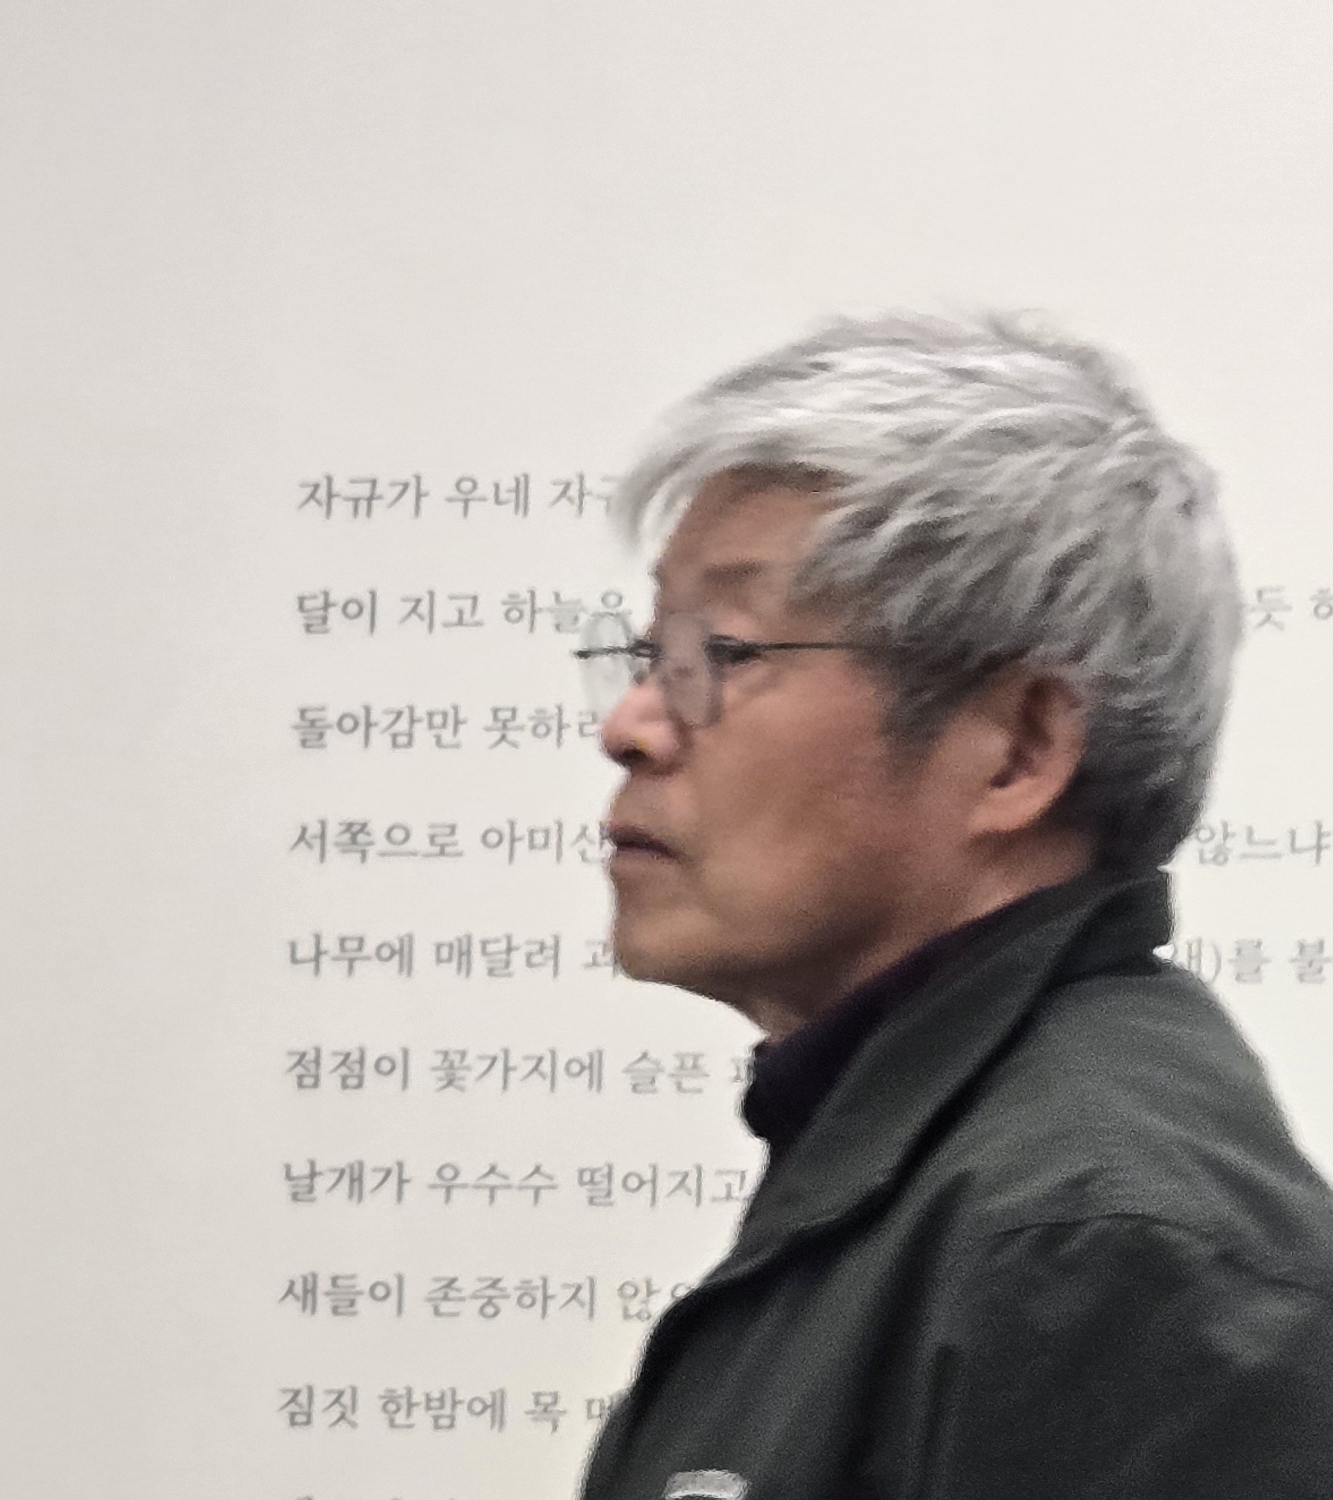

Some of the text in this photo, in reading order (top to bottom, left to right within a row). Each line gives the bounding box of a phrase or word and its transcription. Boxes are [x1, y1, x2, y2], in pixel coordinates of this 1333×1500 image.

[296, 472, 430, 520] 자규가
[443, 471, 532, 520] 우네
[295, 587, 378, 636] 달이
[398, 587, 485, 636] 지고
[289, 703, 468, 751] 돌아감만
[288, 817, 465, 866] 서쪽으로
[286, 931, 415, 979] 나무에
[432, 931, 561, 980] 매달려
[284, 1044, 410, 1093] 점점이
[429, 1045, 605, 1095] 꽃가지에
[621, 1049, 711, 1095] 슬픈
[281, 1157, 753, 1209] 날개가 우수수 떨어지고
[277, 1270, 405, 1319] 새들이
[423, 1273, 597, 1322] 존중하지
[277, 1383, 359, 1431] 짐짓
[376, 1385, 508, 1434] 한밤에
[524, 1389, 568, 1435] 목
